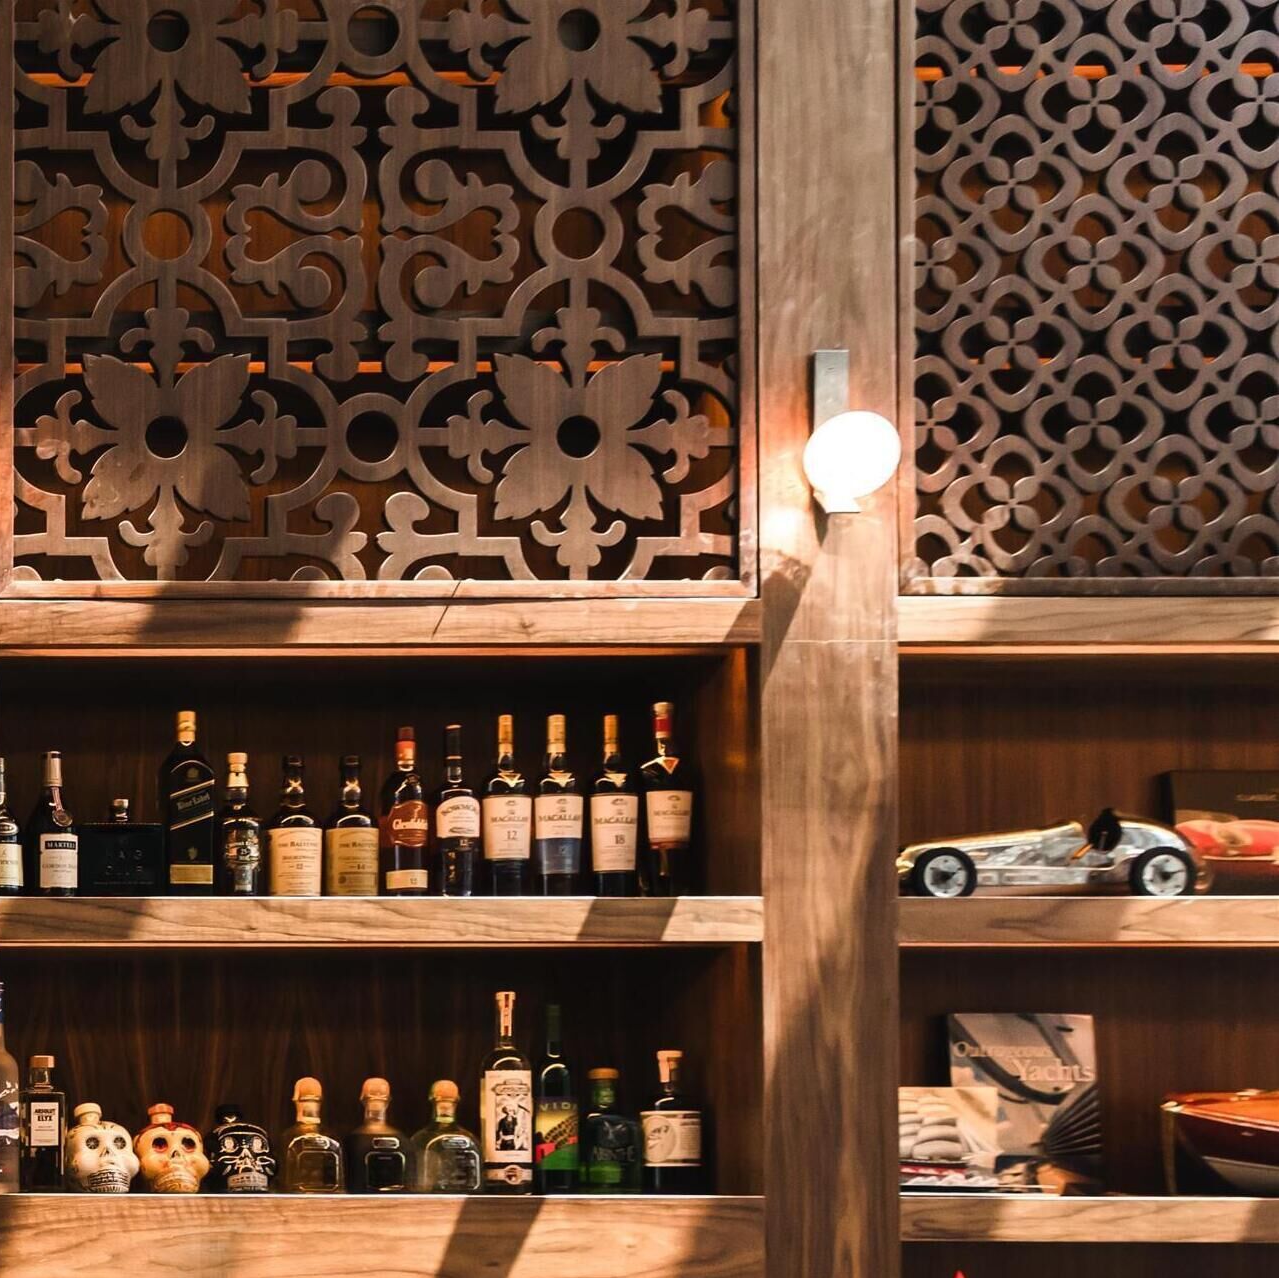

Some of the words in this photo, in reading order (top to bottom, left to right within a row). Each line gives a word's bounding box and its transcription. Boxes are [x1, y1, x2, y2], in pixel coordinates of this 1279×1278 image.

[507, 830, 517, 840] 12
[1010, 1059, 1095, 1082] Yachts
[37, 1114, 52, 1122] ELYX
